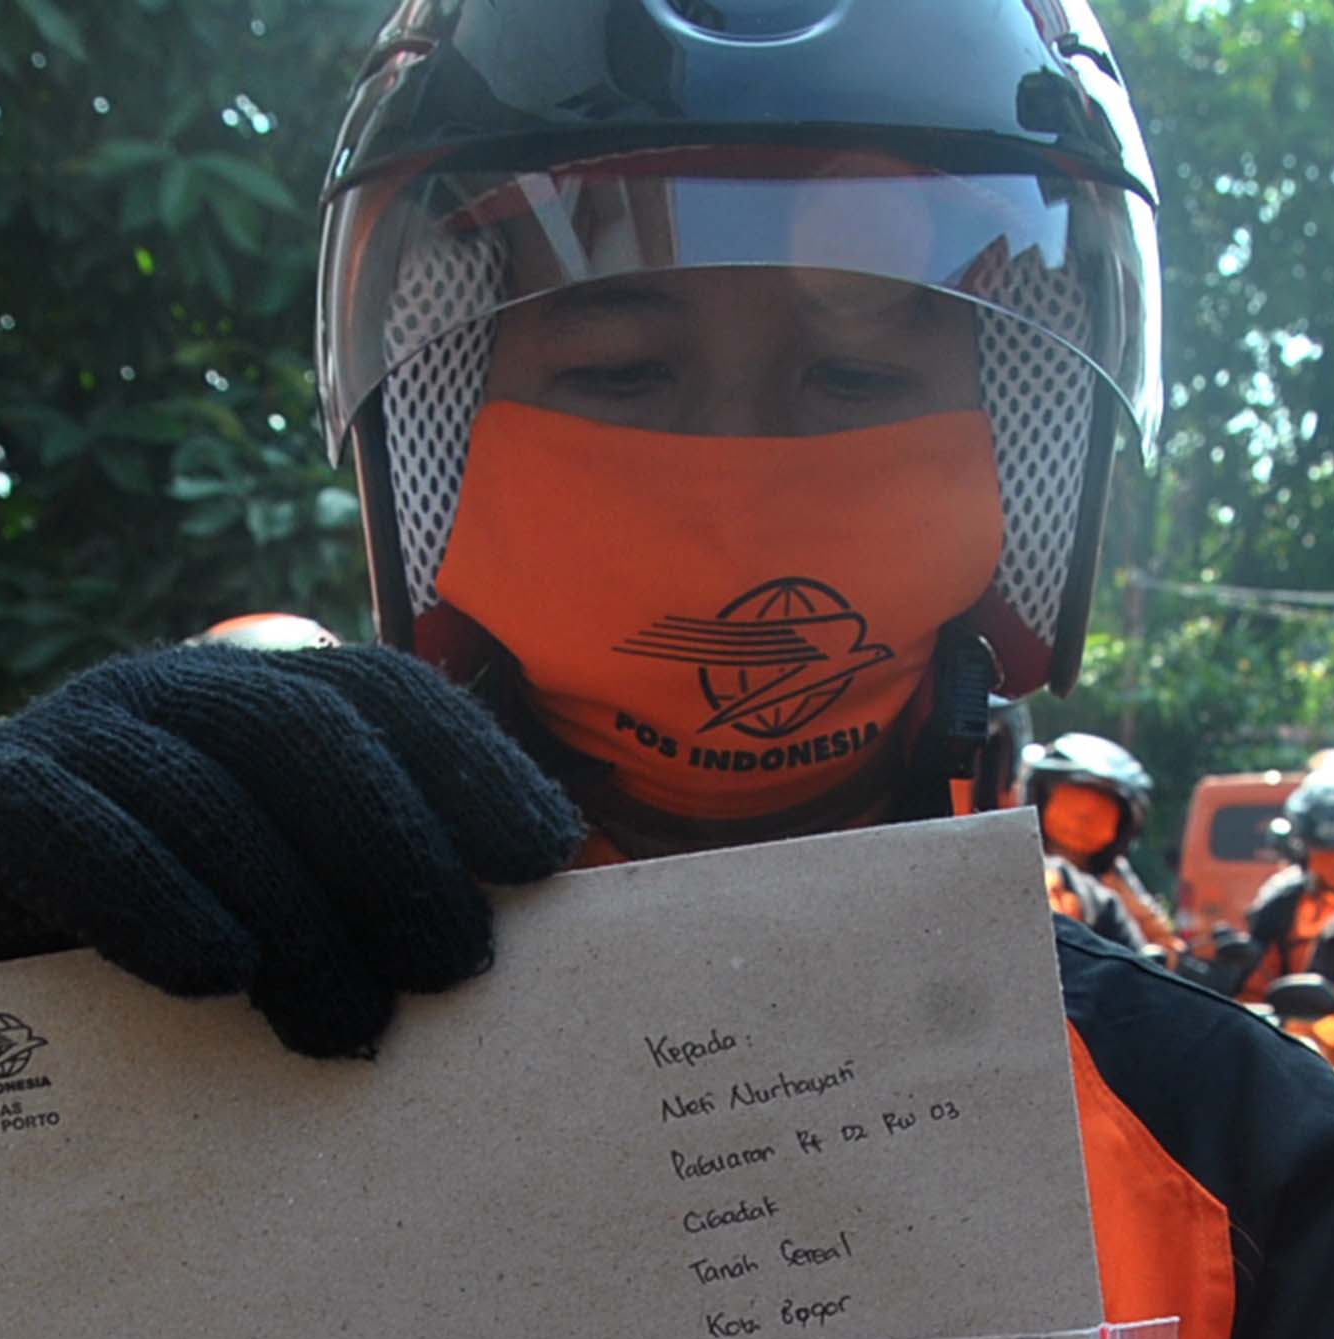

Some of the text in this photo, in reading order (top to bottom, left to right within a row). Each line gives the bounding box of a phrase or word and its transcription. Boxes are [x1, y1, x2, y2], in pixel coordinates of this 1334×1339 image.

[613, 711, 881, 772] POS INDONESIA
[1, 1111, 60, 1132] PORTO
[930, 1101, 960, 1120] 03
[688, 1254, 759, 1285] Tanah
